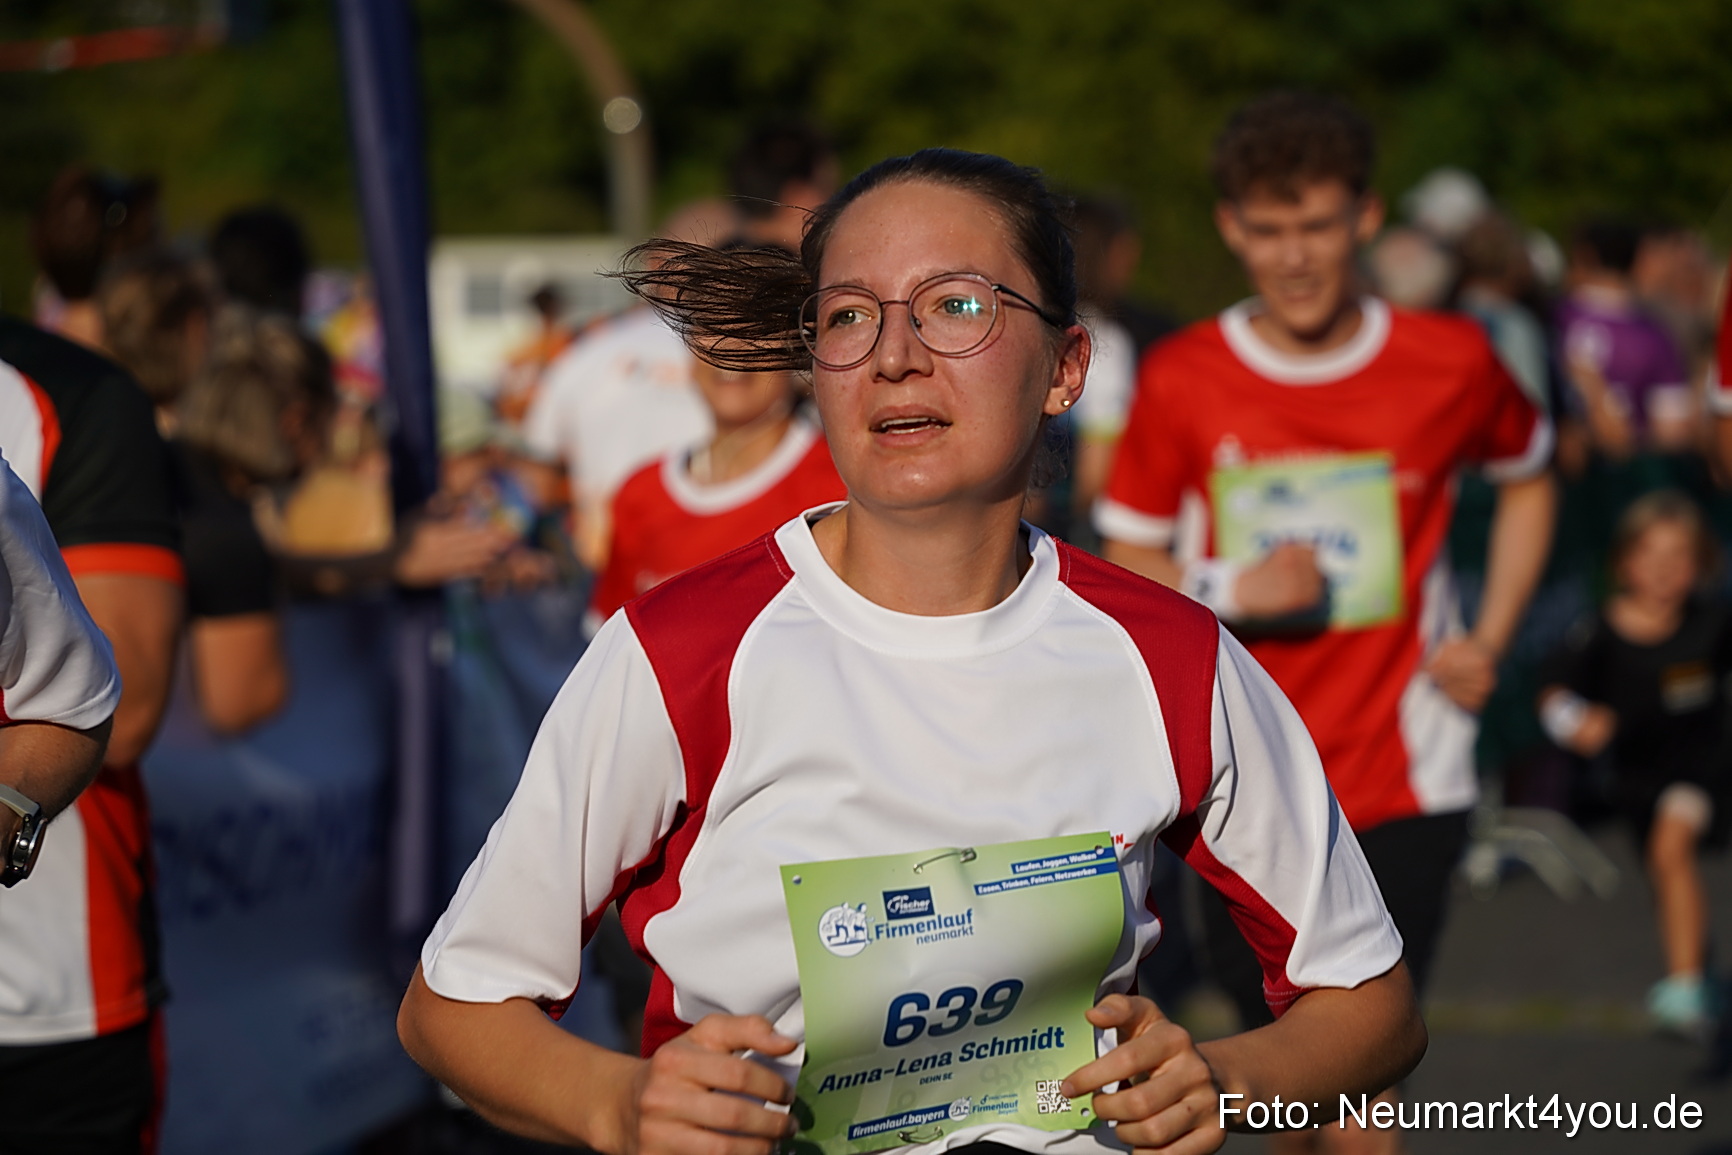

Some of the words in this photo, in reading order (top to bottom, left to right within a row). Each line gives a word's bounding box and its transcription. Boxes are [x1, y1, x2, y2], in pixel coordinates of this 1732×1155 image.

[1015, 860, 1042, 872] Laufen,
[1042, 856, 1069, 868] Joggen,
[1069, 852, 1097, 863] Walken
[978, 884, 1001, 894] Essen,
[1002, 879, 1030, 890] Trinken,
[1030, 874, 1054, 885] Feiern,
[1055, 867, 1097, 880] Netzwerken
[874, 908, 973, 941] Firmenlauf
[916, 925, 974, 945] neumarkt
[882, 978, 1024, 1049] 639
[817, 1050, 952, 1094] Anna-Lena
[958, 1026, 1065, 1063] Schmidt
[919, 1074, 942, 1085] DEHN
[943, 1072, 954, 1082] SE
[972, 1100, 1019, 1114] Firmenlauf
[852, 1109, 945, 1138] firmenlauf.bayern
